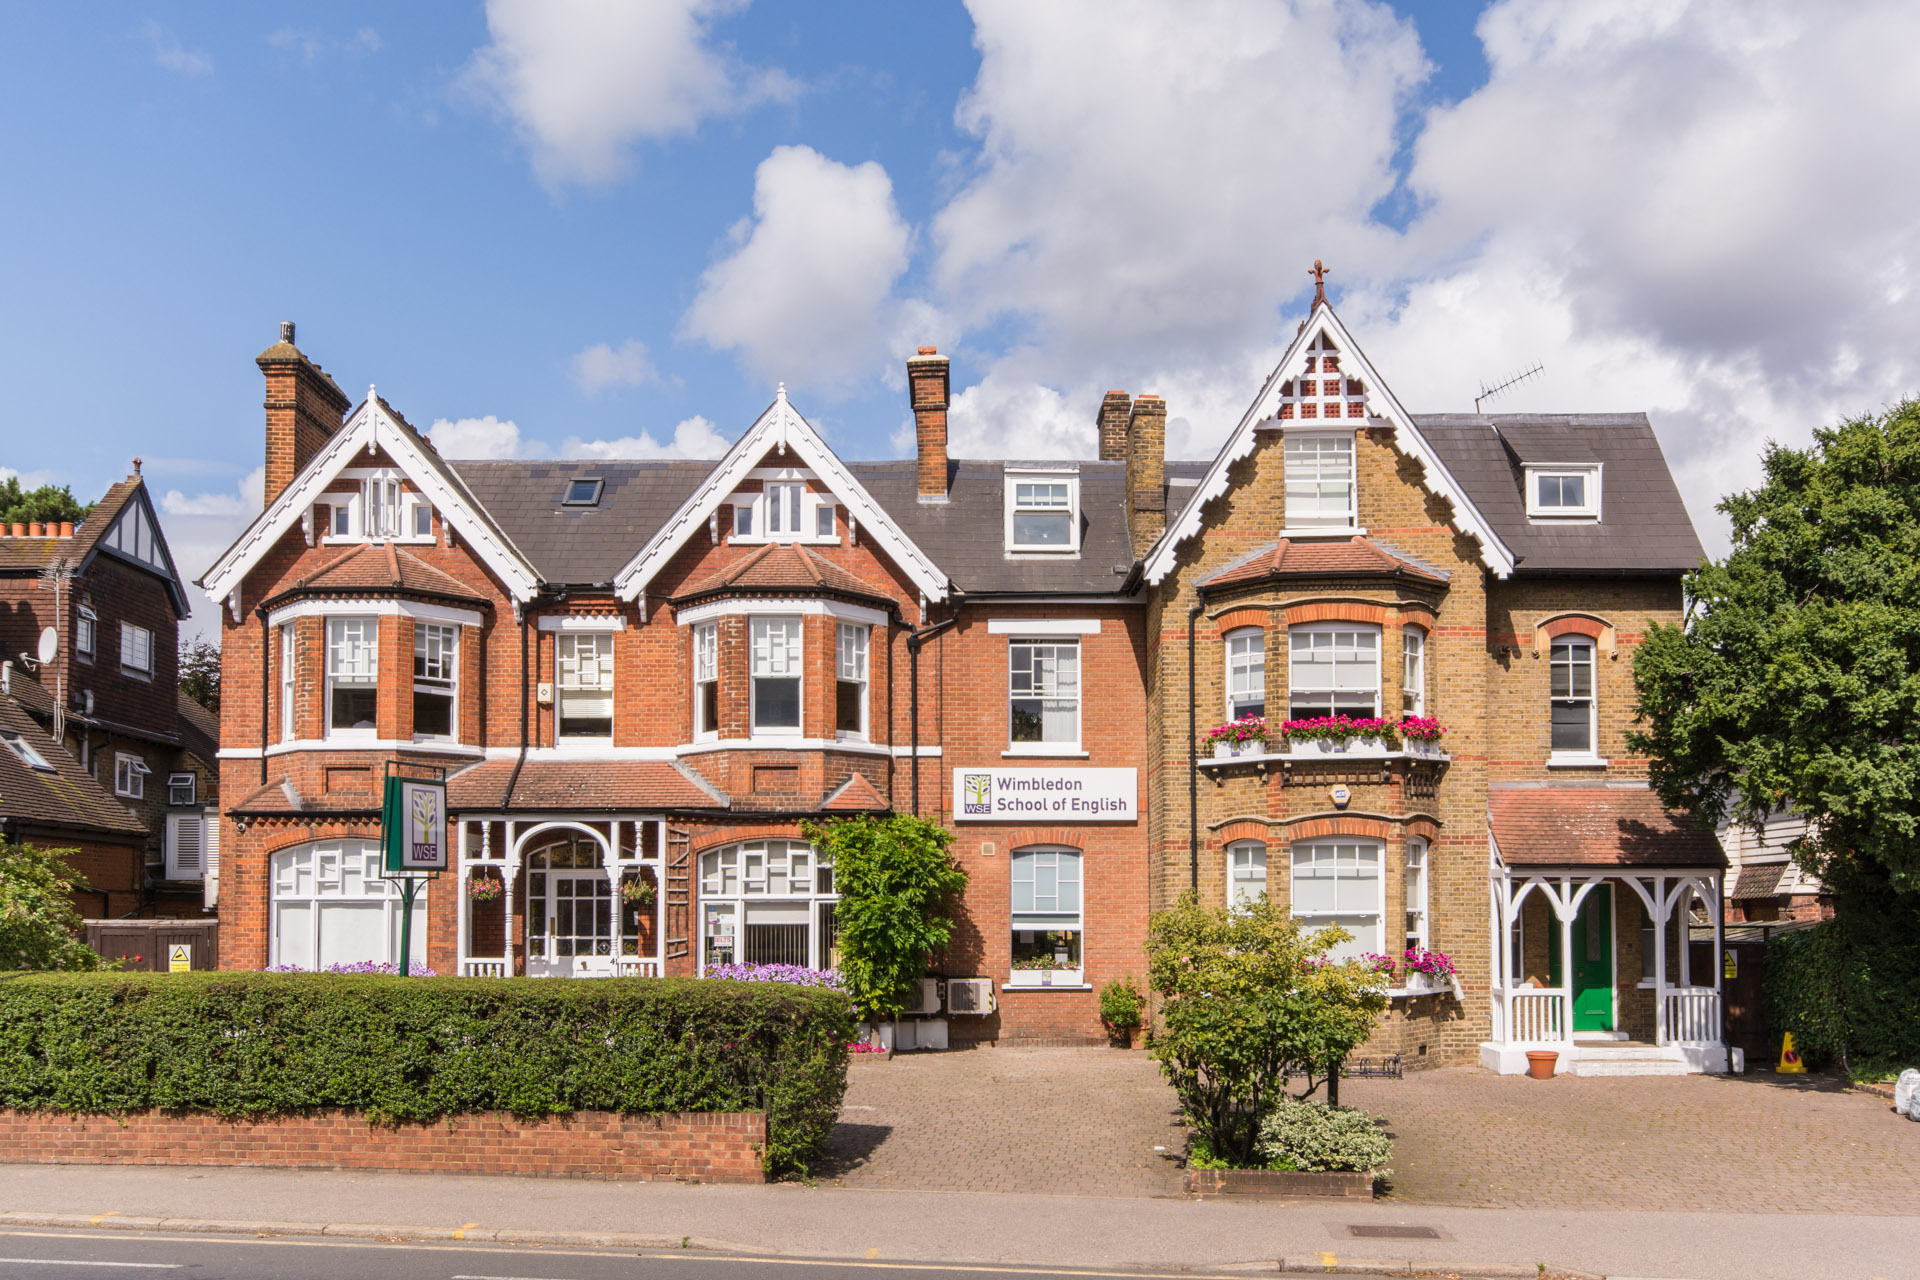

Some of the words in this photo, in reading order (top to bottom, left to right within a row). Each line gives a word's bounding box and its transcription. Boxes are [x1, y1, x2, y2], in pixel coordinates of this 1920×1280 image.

[997, 777, 1082, 791] Wimbledon
[965, 804, 991, 814] WSE
[997, 797, 1048, 811] School
[1052, 797, 1067, 811] of
[1071, 797, 1127, 814] English
[413, 844, 437, 860] WSE
